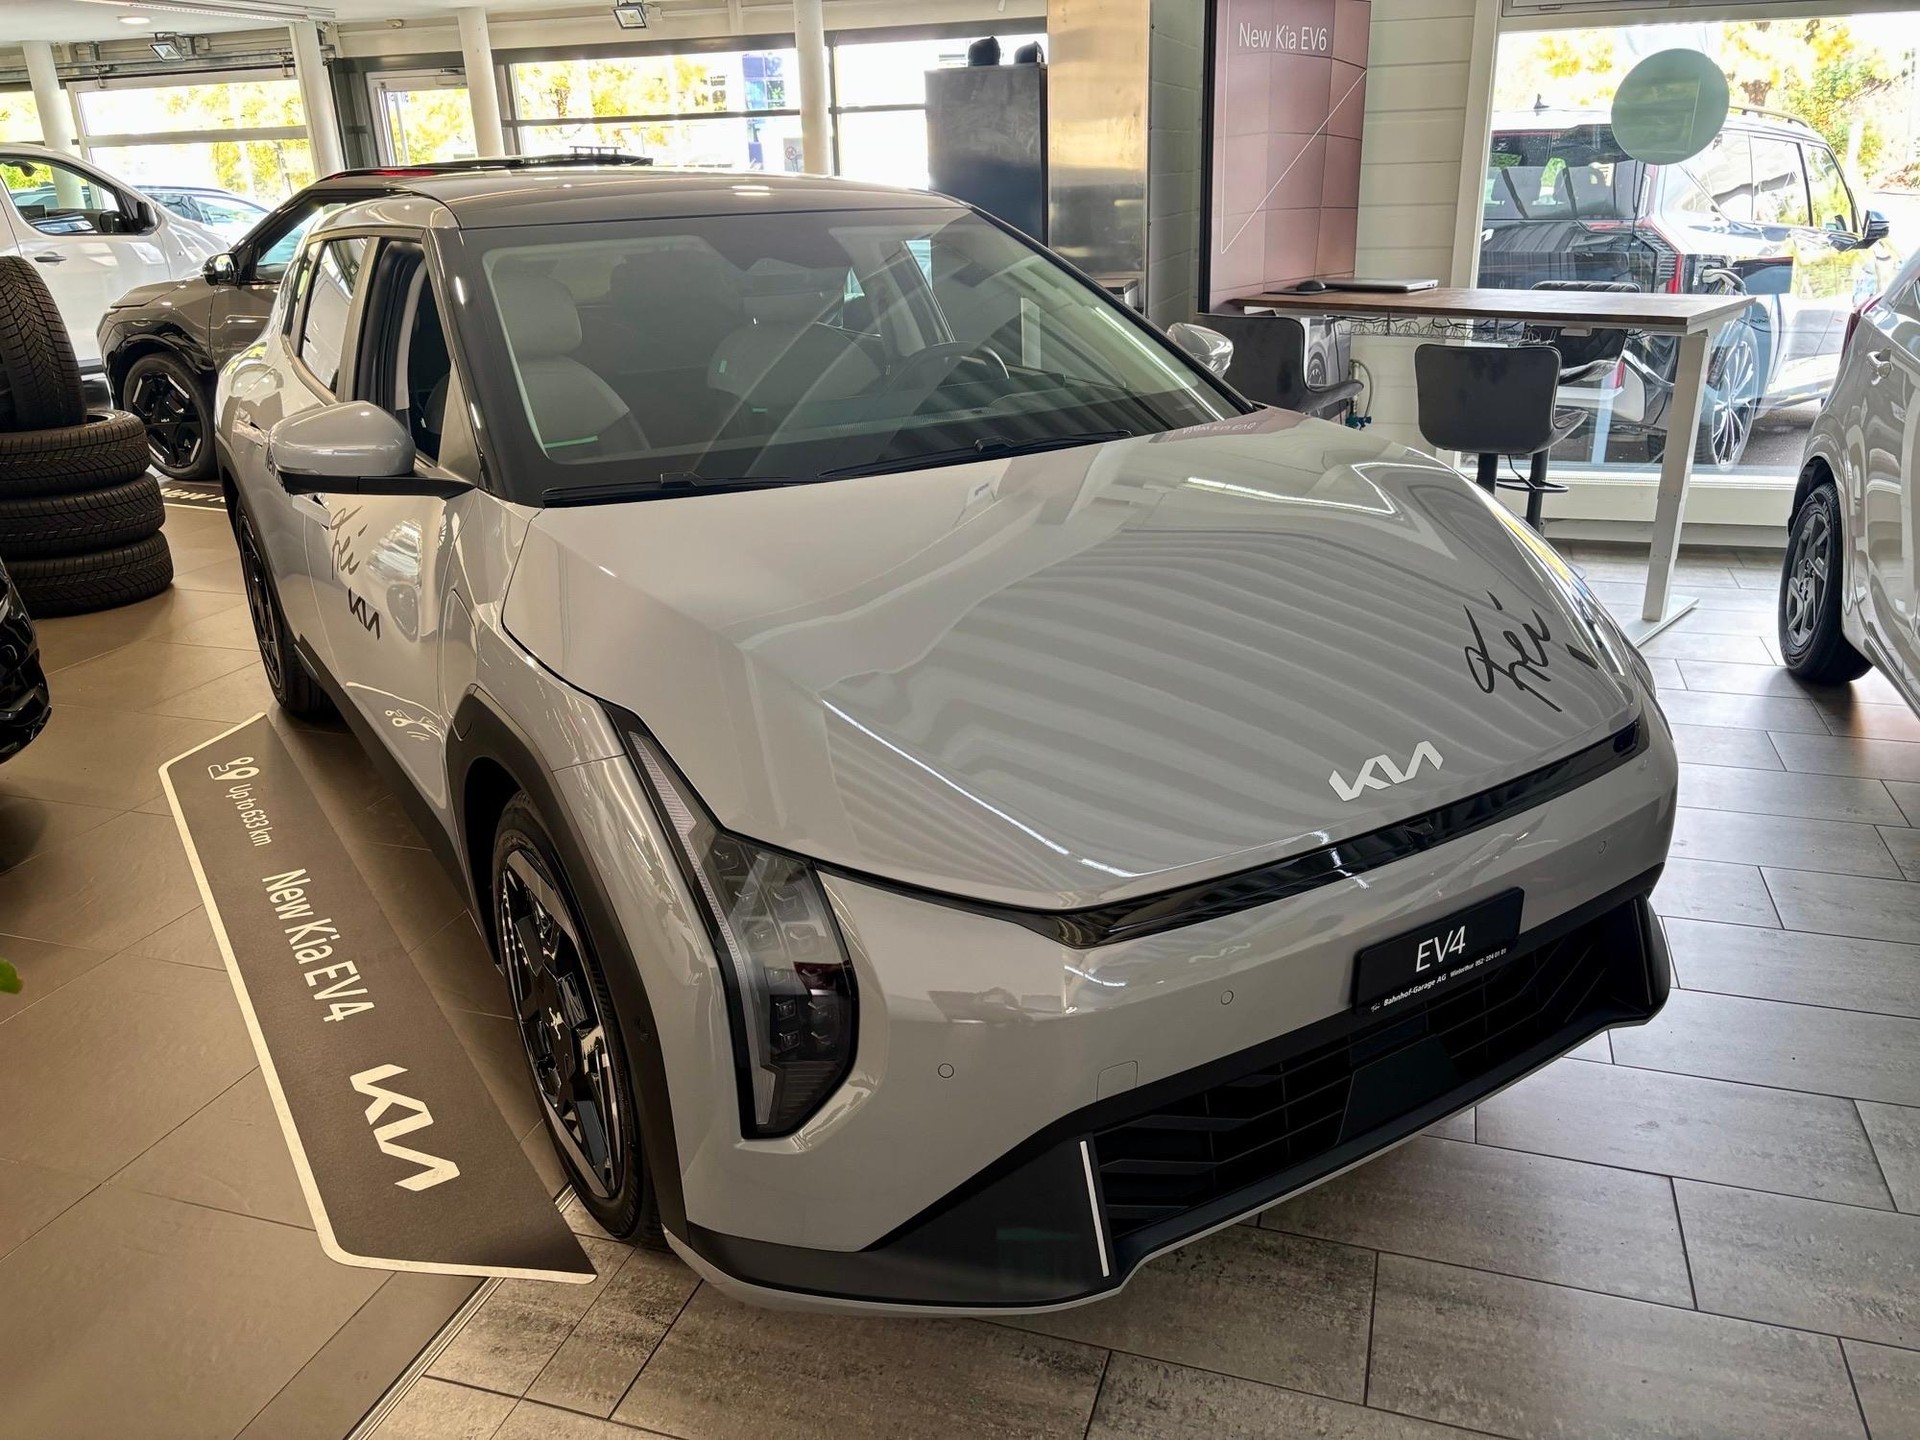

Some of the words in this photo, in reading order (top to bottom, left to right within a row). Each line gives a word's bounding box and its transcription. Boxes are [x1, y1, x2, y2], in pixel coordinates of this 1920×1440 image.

[1239, 22, 1272, 48] New
[1275, 23, 1297, 50] Kia
[1301, 26, 1327, 51] EV6
[225, 783, 253, 799] Up
[235, 798, 257, 810] to
[241, 809, 270, 829] 633
[248, 827, 273, 847] km
[261, 868, 314, 921] New
[284, 918, 340, 965] Kia
[1415, 925, 1466, 973] EV4
[304, 960, 375, 1023] EV4
[1383, 979, 1436, 1007] Bahnhof-Garage
[1436, 973, 1447, 984] AG
[1450, 963, 1475, 978] Winterthur
